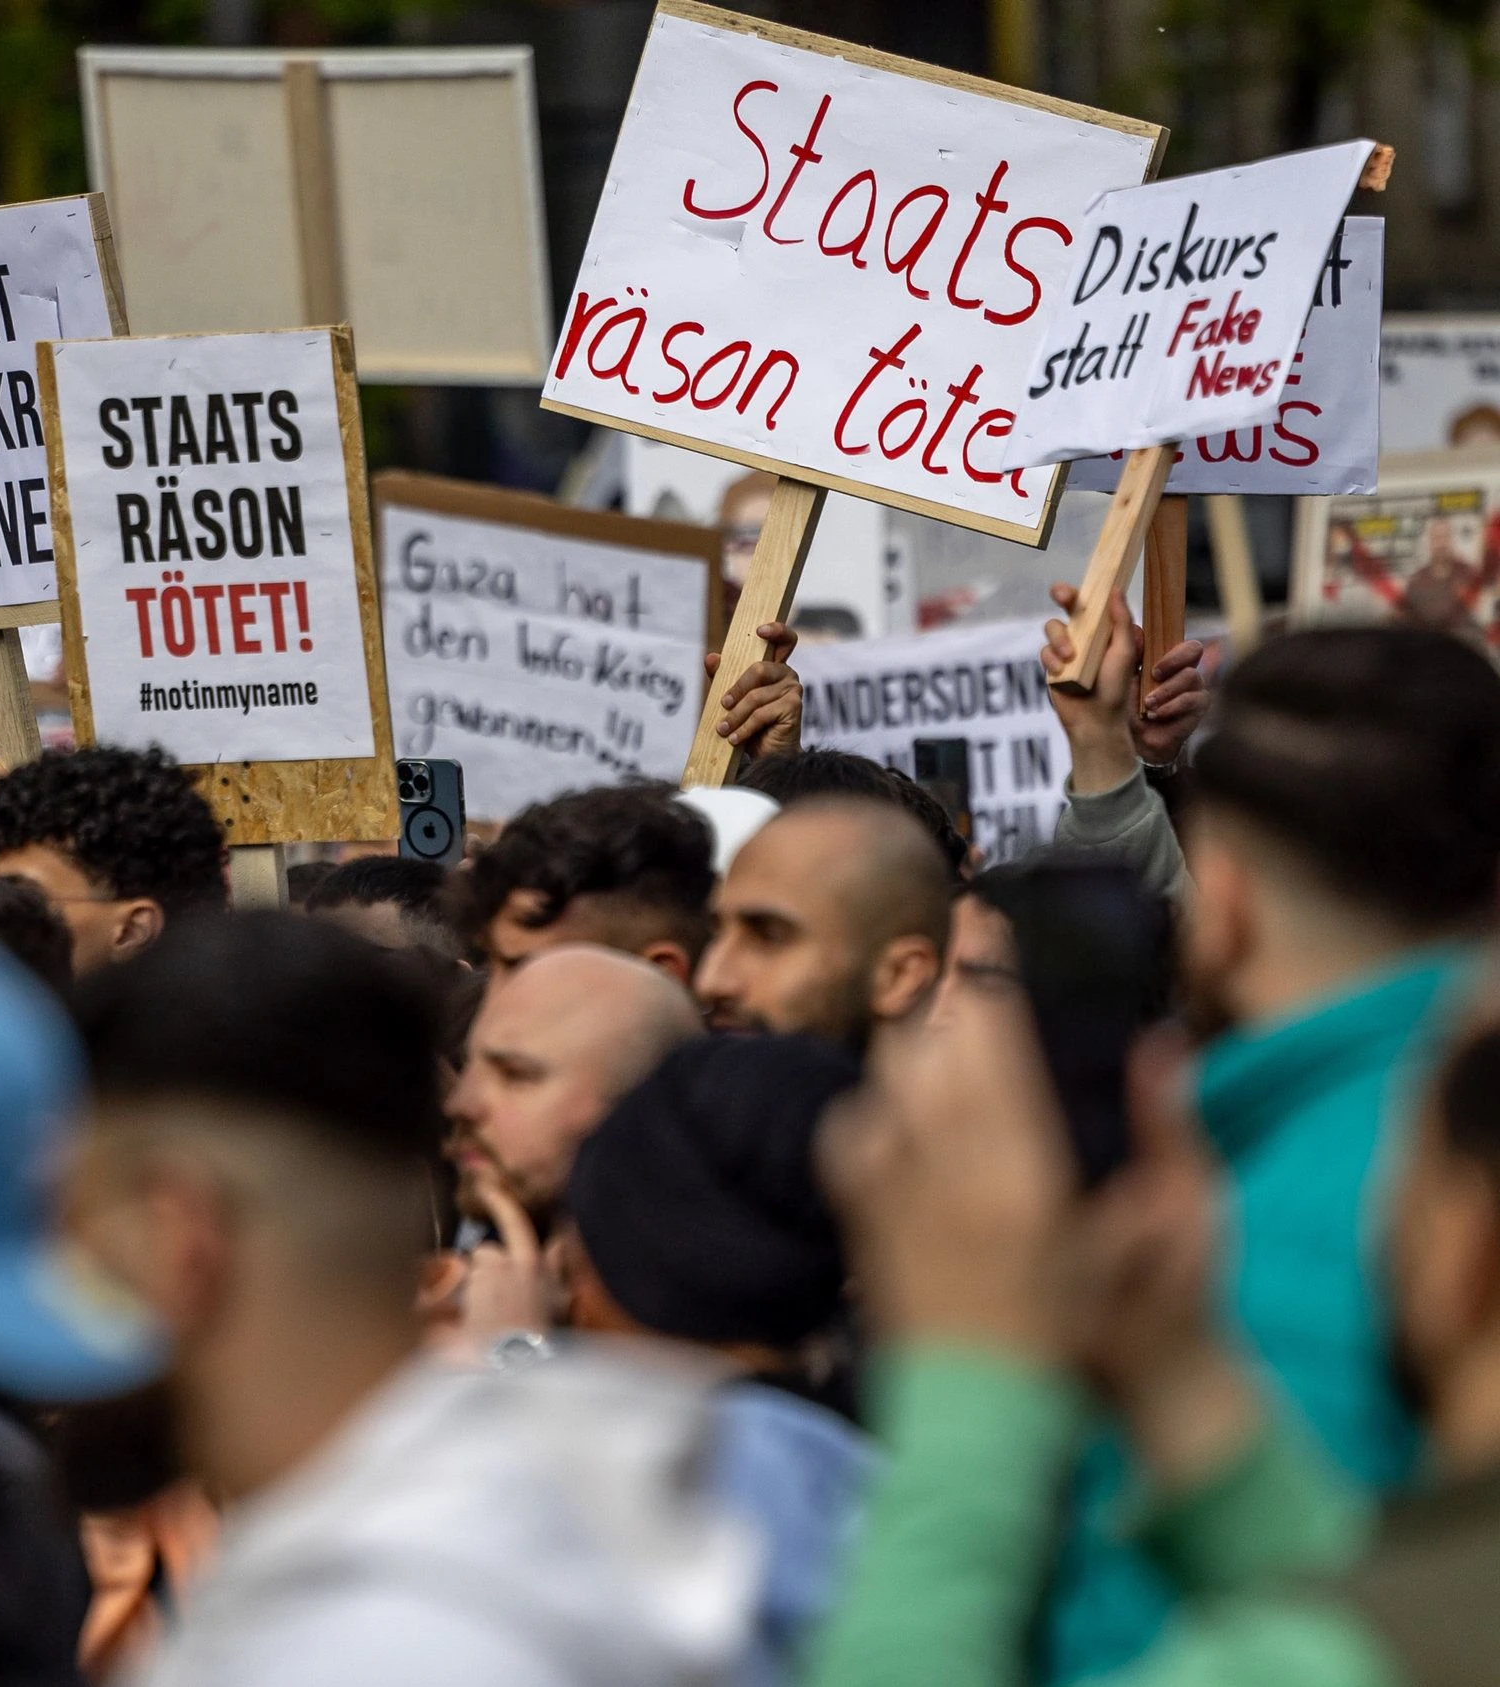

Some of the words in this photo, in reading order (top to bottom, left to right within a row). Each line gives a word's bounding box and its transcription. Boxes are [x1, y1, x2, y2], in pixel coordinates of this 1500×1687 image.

[682, 79, 1074, 325] Staats
[1073, 202, 1279, 307] Diskurs
[1028, 312, 1150, 400] statt
[1166, 290, 1263, 358] Fake
[1186, 350, 1281, 401] News
[98, 388, 304, 470] STAATS
[554, 286, 800, 431] räson
[833, 323, 1029, 498] töte
[115, 475, 308, 564] RÄSON
[124, 569, 315, 658] TÖTET!
[138, 679, 320, 717] #notinmyname
